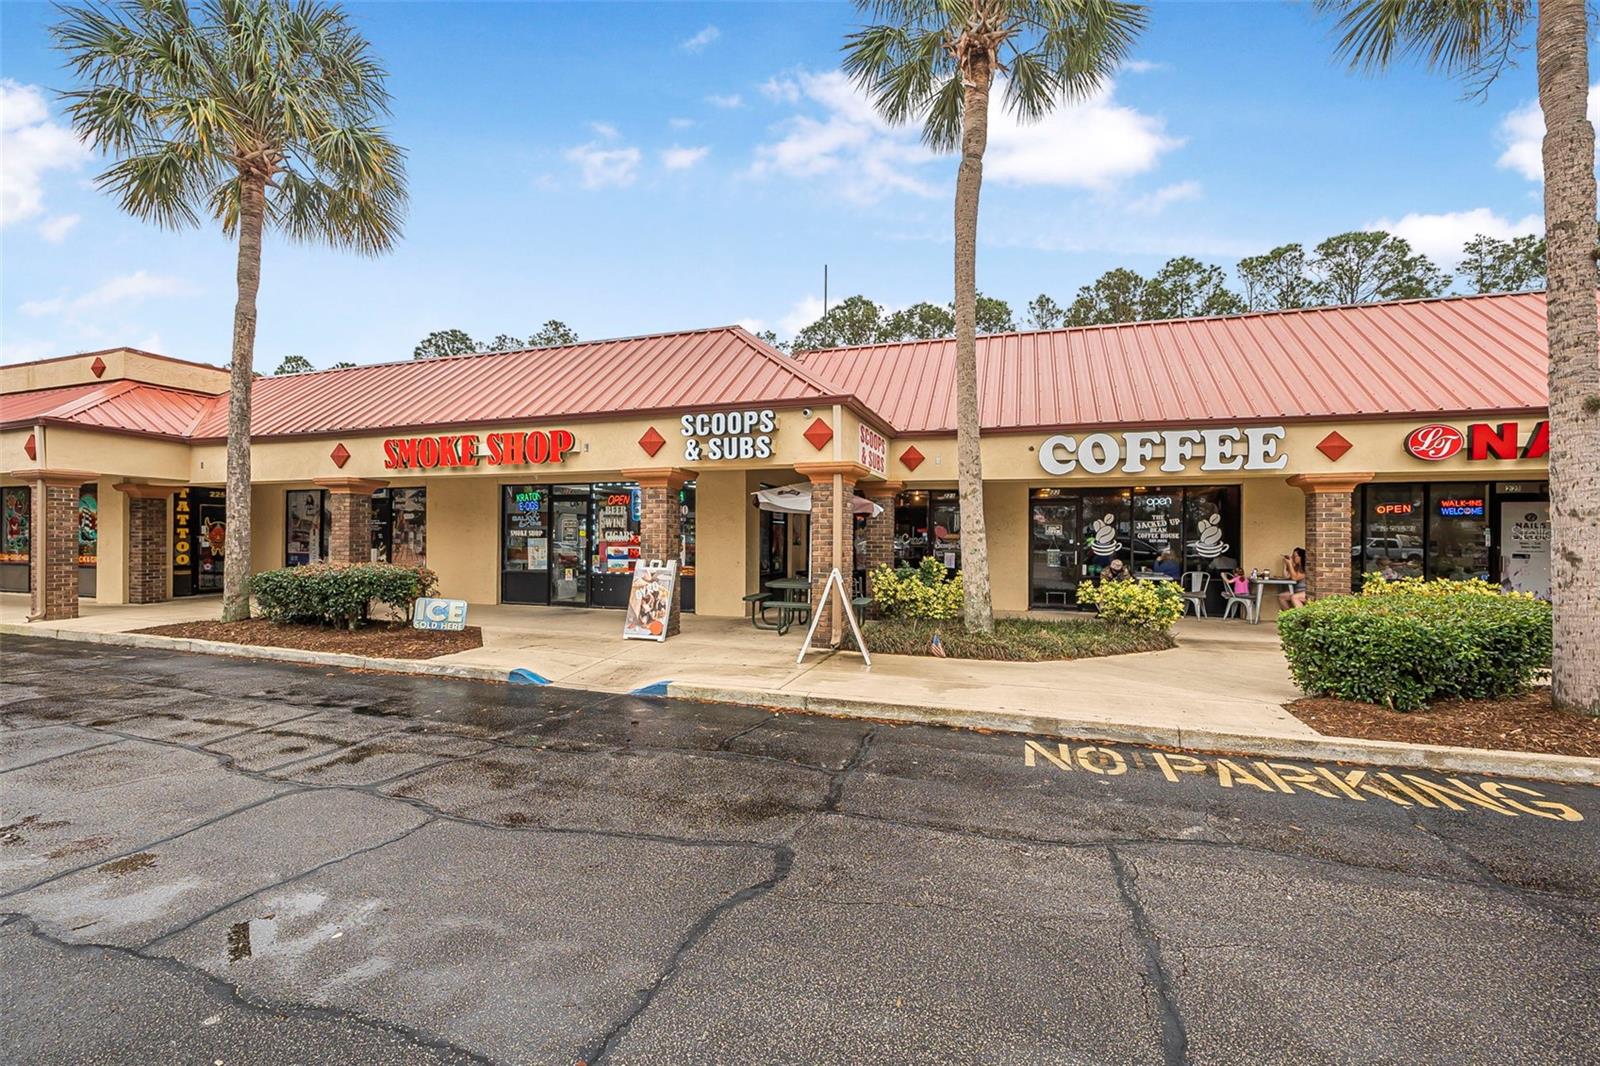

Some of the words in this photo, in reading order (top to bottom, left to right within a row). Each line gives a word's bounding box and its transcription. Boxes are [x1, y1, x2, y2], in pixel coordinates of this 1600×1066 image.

[680, 409, 777, 436] SCOOPS
[383, 435, 479, 469] SMOKE
[487, 429, 575, 465] SHOP
[685, 439, 702, 461] &
[709, 435, 773, 460] SUBS
[860, 426, 886, 455] SCOOPS
[1038, 426, 1288, 475] COFFEE
[861, 449, 868, 465] &
[868, 452, 885, 473] SUBS
[605, 506, 627, 515] BEER
[607, 495, 630, 505] OPEN
[1146, 497, 1172, 507] open
[1376, 504, 1411, 513] OPEN
[1440, 507, 1483, 515] WELCOME
[175, 488, 190, 565] TATTOO
[605, 518, 626, 528] WINE
[1136, 520, 1167, 529] JACKED
[1169, 518, 1180, 526] UP
[416, 599, 464, 622] ICE
[413, 621, 438, 629] SOLD
[440, 622, 464, 630] HERE
[1024, 740, 1128, 776] NO
[1152, 752, 1584, 822] PARKING
